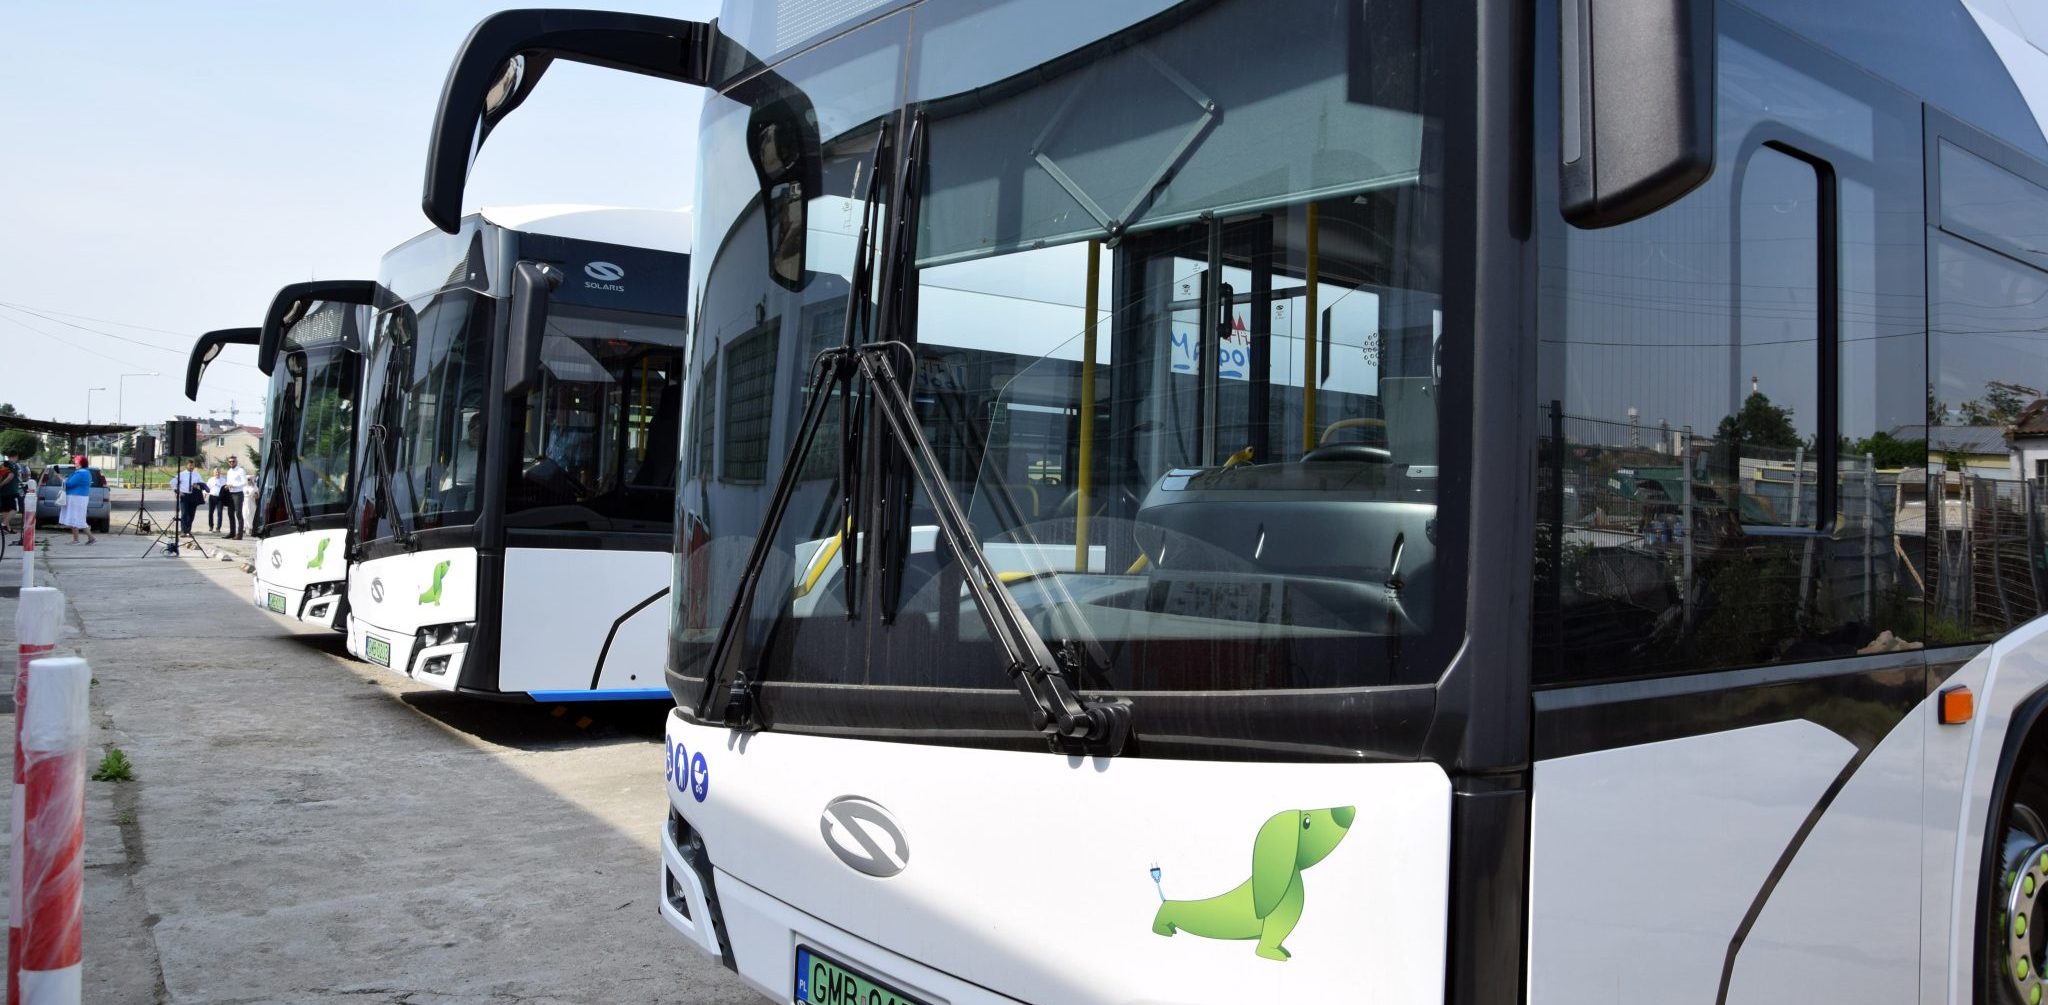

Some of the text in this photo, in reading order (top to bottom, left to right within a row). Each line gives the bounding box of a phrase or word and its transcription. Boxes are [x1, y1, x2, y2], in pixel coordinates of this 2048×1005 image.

[584, 281, 625, 292] SOLARIS
[799, 979, 807, 992] PL
[813, 963, 857, 1005] GMB
